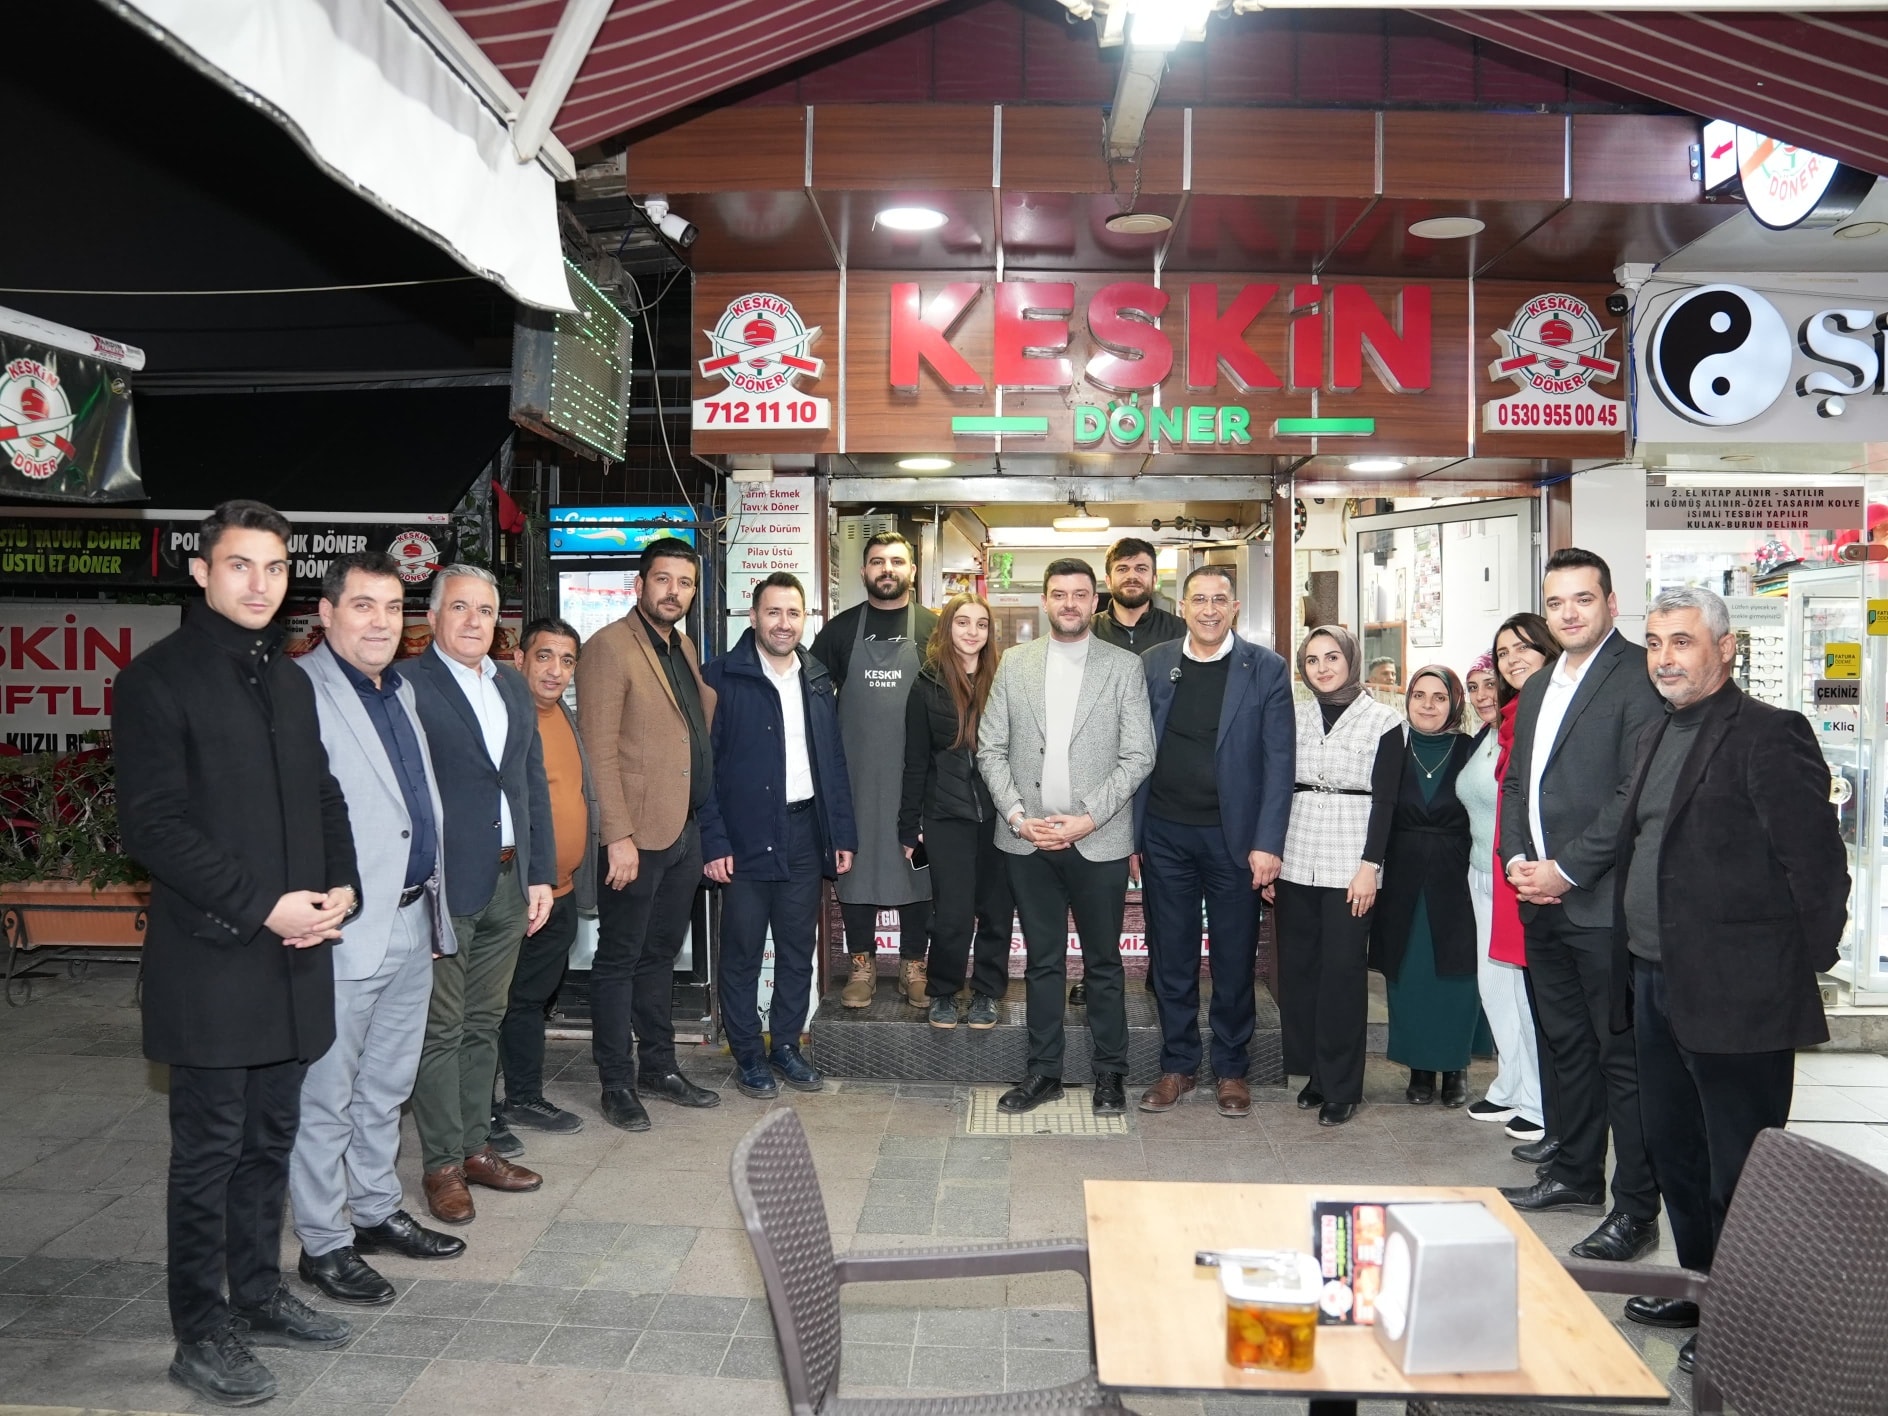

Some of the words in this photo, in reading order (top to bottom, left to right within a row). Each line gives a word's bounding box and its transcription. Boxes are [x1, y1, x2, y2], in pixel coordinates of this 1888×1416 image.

[734, 373, 787, 392] DÖNER
[1531, 373, 1585, 394] DÖNER
[704, 401, 749, 423] 712
[755, 401, 778, 423] 11
[786, 401, 817, 423] 10
[1498, 404, 1508, 426] 0
[1511, 404, 1542, 427] 530
[1543, 404, 1572, 427] 955
[1574, 404, 1595, 427] 00
[1597, 404, 1618, 427] 45
[12, 455, 59, 479] DÖNER
[770, 489, 800, 498] Ekmek
[1672, 489, 1682, 497] 2.
[1685, 489, 1697, 497] EL
[1735, 489, 1771, 497] ALINIR
[1783, 489, 1824, 497] SATILIR
[771, 502, 799, 511] Döner
[1664, 498, 1701, 509] GÜMÜŞ
[1777, 499, 1824, 508] TASARIM
[1828, 499, 1860, 508] KOLYE
[1766, 510, 1808, 518] YAPILIR
[741, 525, 766, 533] Tavuk
[769, 523, 801, 533] Dürüm
[1687, 520, 1763, 529] KULAK-BURUN
[87, 526, 141, 550] DÖNER
[312, 530, 367, 554] DÖNER
[747, 547, 769, 556] Pilav
[772, 545, 793, 556] Üstü
[3, 549, 45, 572] ÜSTÜ
[49, 555, 66, 573] ET
[68, 550, 122, 574] DÖNER
[742, 561, 767, 569] Tavuk
[770, 560, 798, 569] Döner
[1817, 685, 1858, 700] ÇEKİNİZ
[1833, 721, 1855, 732] Kliq
